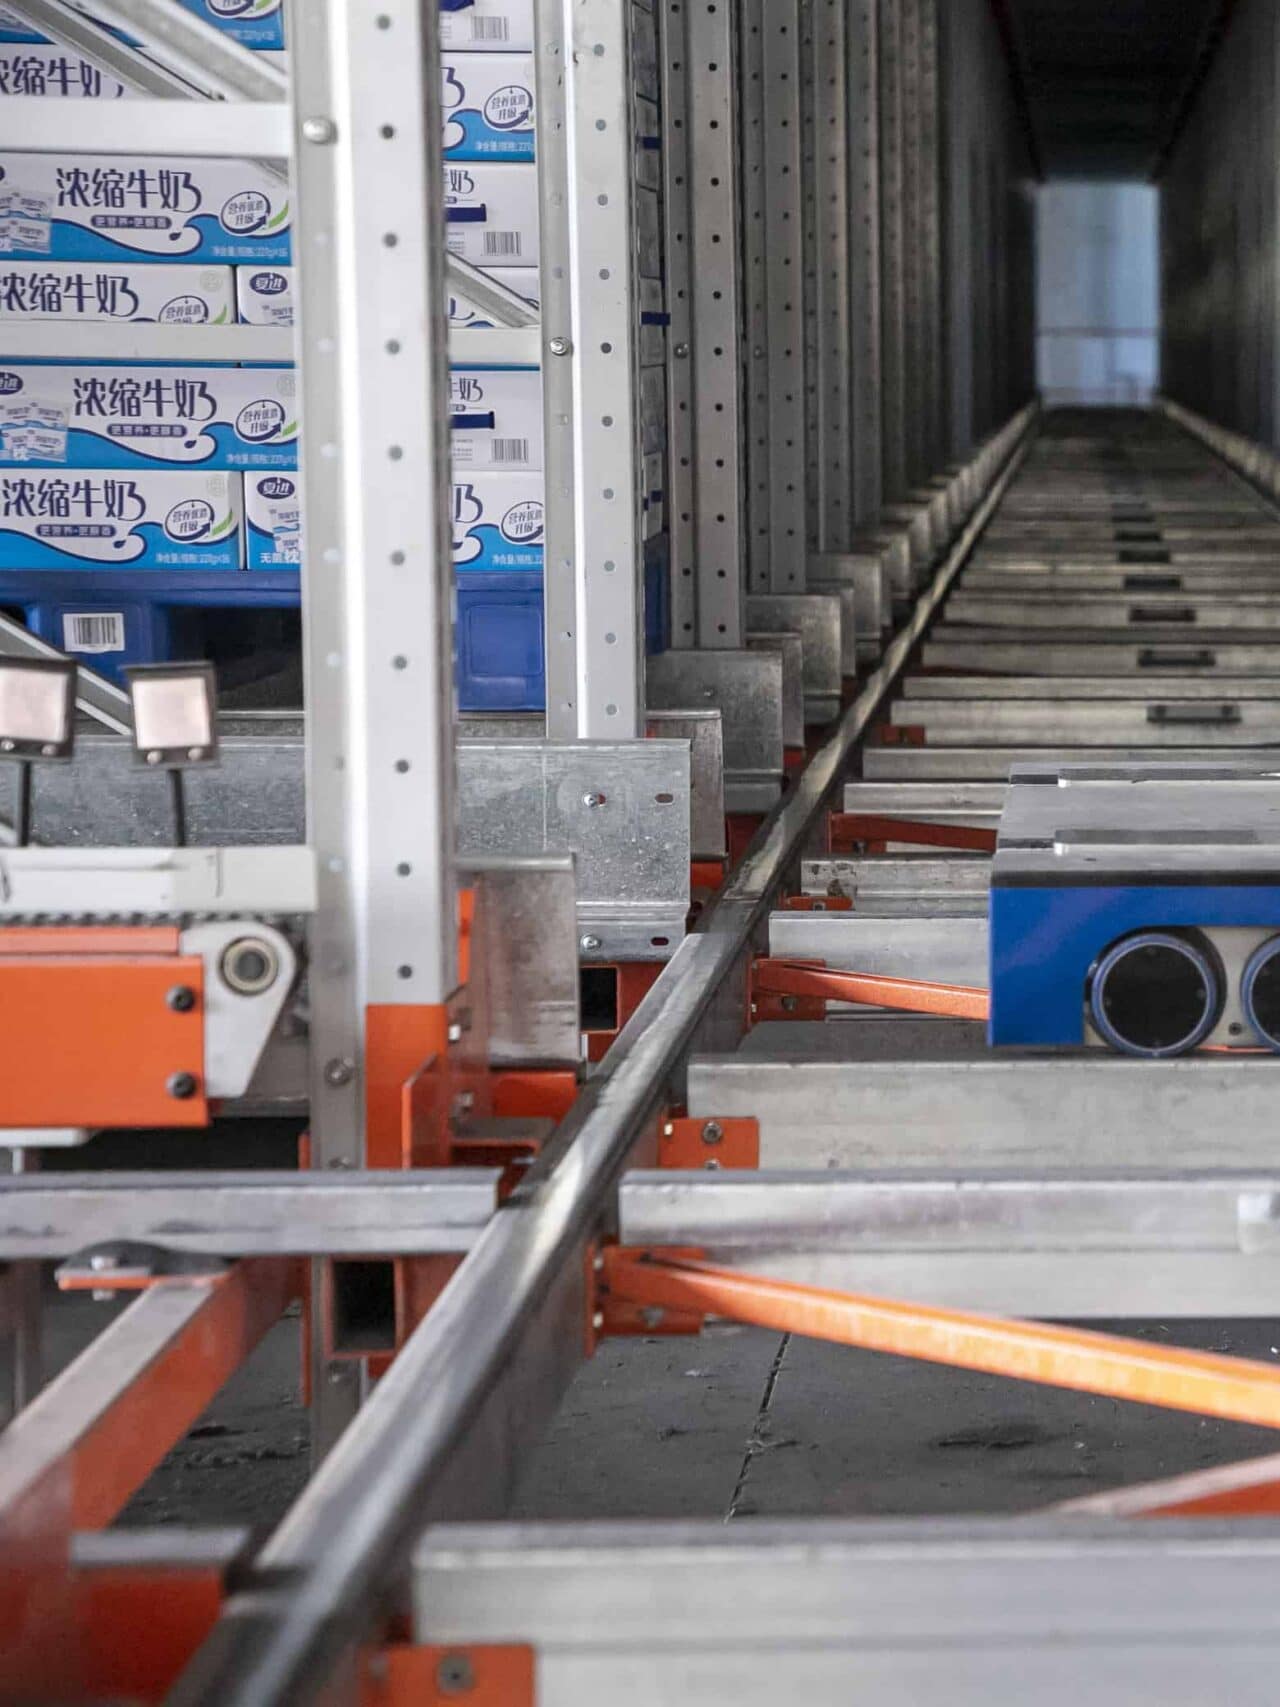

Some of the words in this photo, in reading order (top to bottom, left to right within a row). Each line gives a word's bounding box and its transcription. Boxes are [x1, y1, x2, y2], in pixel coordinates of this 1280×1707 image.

[56, 167, 202, 213] 浓缩牛奶
[0, 273, 140, 318] 浓缩牛奶
[73, 377, 217, 422] 浓缩牛奶
[2, 478, 147, 522] 浓缩牛奶
